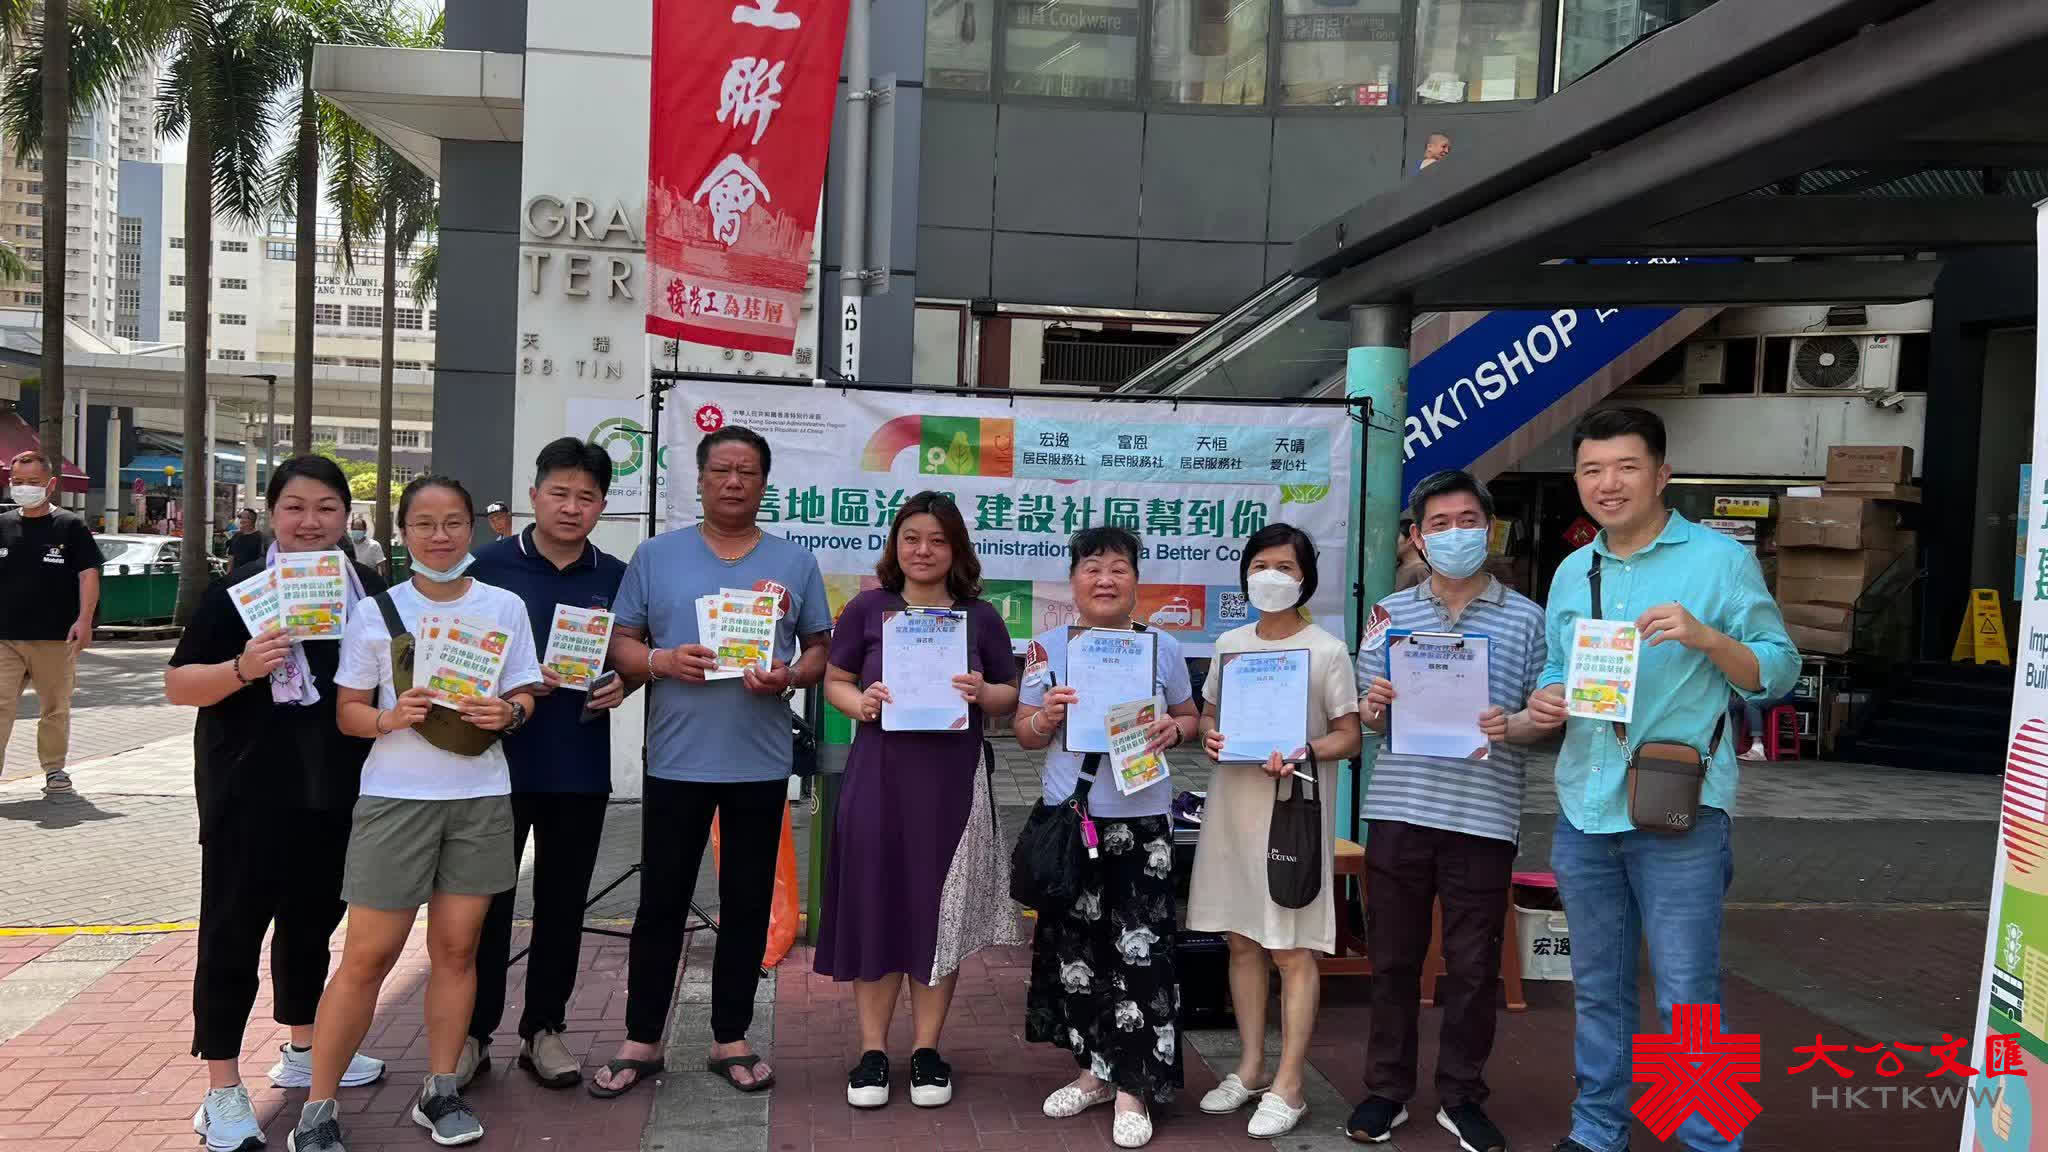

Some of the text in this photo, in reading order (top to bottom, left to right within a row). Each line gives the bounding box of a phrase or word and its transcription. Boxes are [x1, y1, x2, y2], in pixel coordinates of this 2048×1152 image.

[1050, 8, 1121, 30] Cookware
[526, 194, 645, 244] GRA
[524, 251, 634, 300] TER
[340, 287, 362, 296] YING
[576, 360, 623, 378] TIN
[1402, 309, 1578, 463] RKnSHOP
[1039, 432, 1070, 448] 宏逸
[1117, 434, 1148, 450] 富恩
[1275, 438, 1305, 454] 天晴
[1022, 453, 1086, 467] 居民服務社
[1101, 455, 1164, 469] 居民服務社
[1180, 456, 1242, 470] 居民服務社
[974, 493, 1268, 538] 建設社區幫到你
[786, 530, 862, 552] Improve
[868, 534, 886, 551] Di
[1140, 546, 1150, 560] a
[1156, 544, 1210, 561] Better
[1215, 545, 1242, 562] Co
[2029, 626, 2048, 659] Imp
[1667, 812, 1689, 827] MK
[1533, 937, 1571, 956] 宏逸
